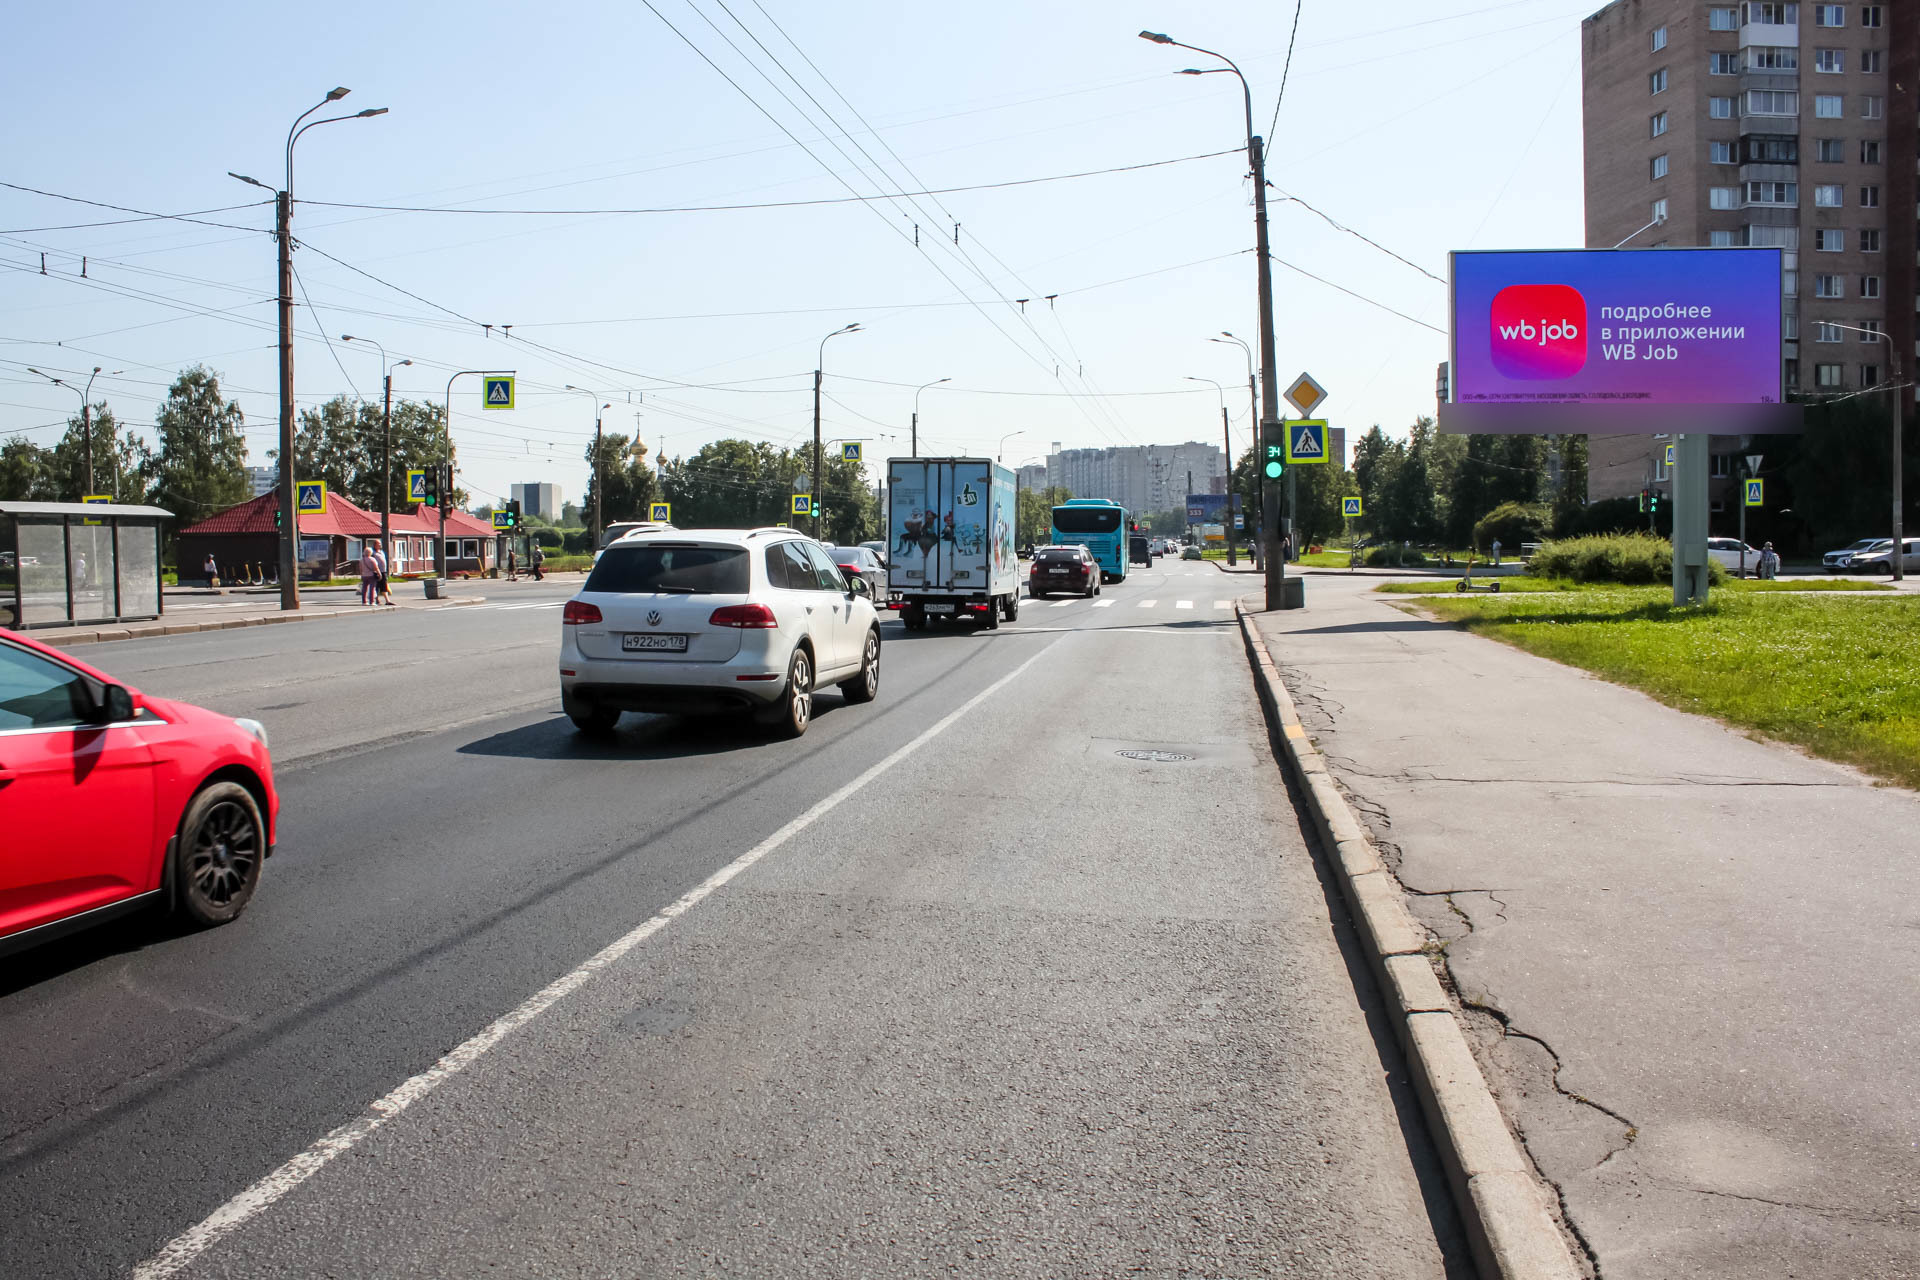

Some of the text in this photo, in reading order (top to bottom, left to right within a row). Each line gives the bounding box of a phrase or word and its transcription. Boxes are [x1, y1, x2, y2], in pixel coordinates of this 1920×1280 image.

[1601, 303, 1711, 322] подробнее
[1499, 318, 1578, 346] wb job
[1601, 327, 1745, 343] в приложении
[1602, 344, 1678, 360] WB Job
[1268, 446, 1280, 457] 34
[670, 636, 684, 646] 178
